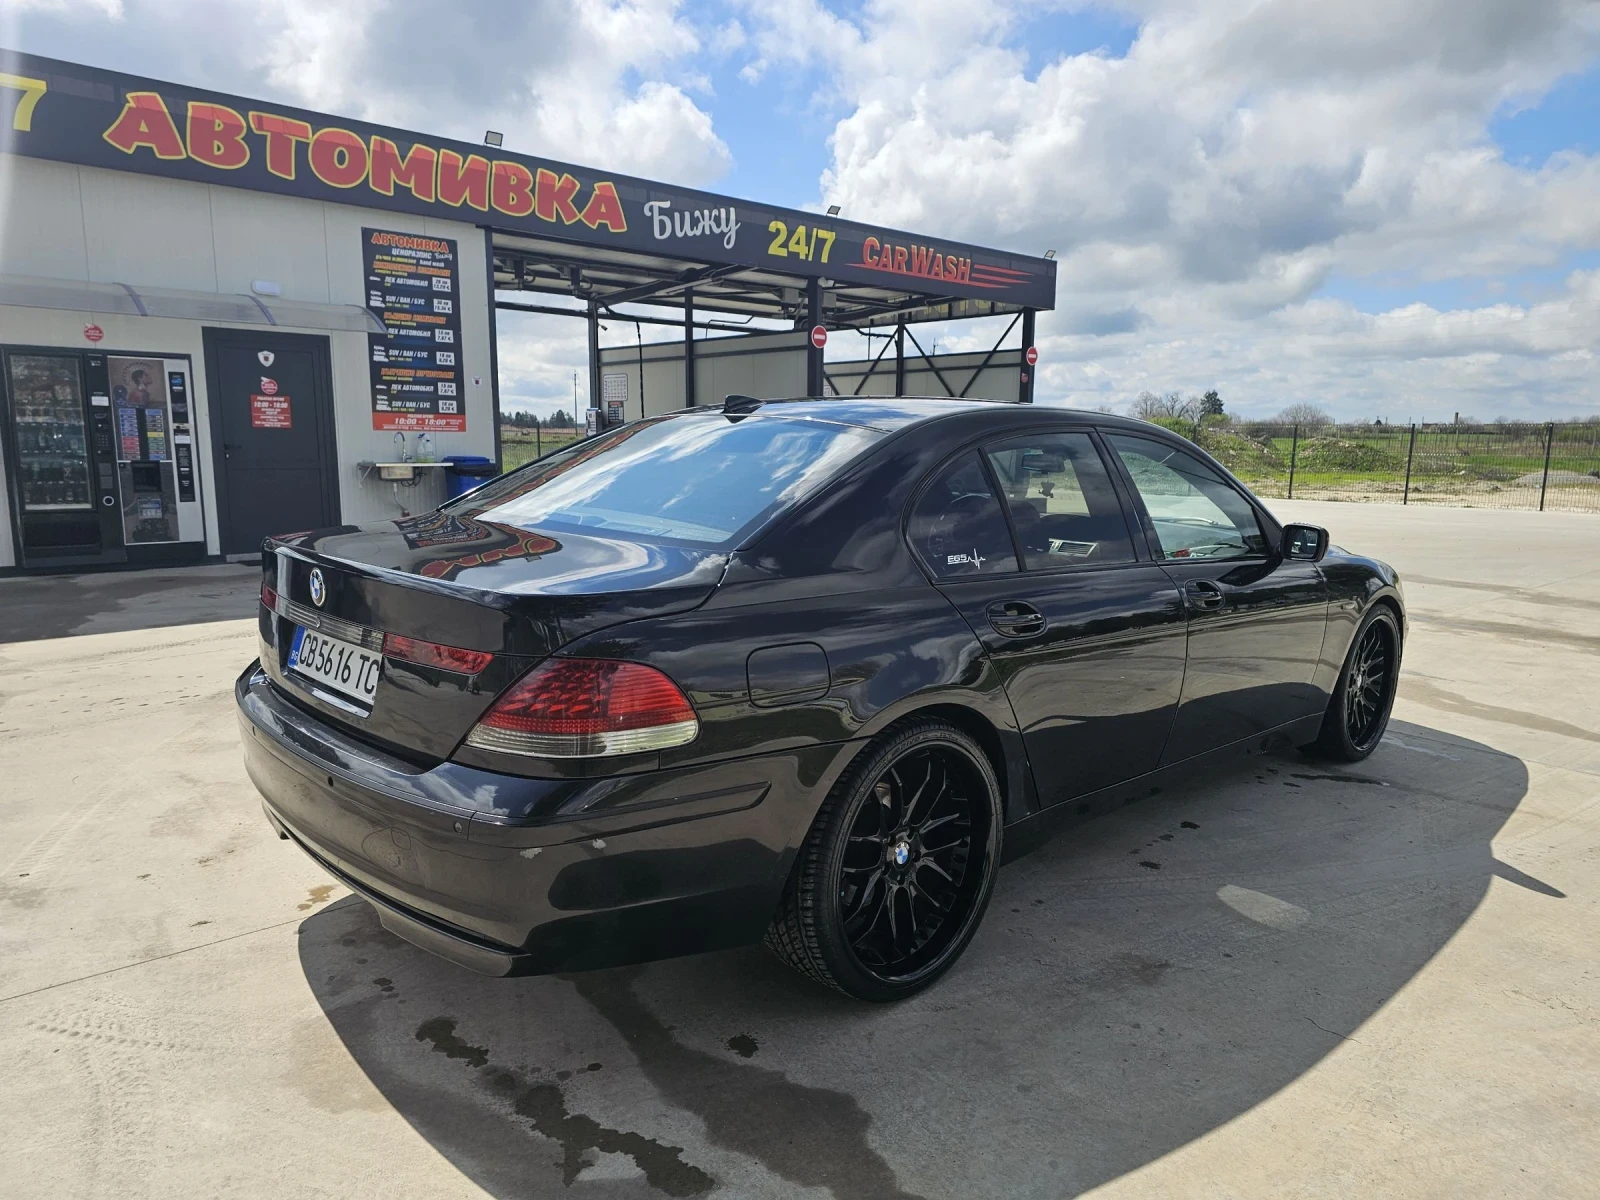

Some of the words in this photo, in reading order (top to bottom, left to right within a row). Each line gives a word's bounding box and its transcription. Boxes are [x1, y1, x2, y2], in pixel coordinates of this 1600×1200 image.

[103, 91, 628, 232] АВТОМИВКА
[643, 200, 742, 249] Бижу
[371, 232, 449, 253] АВТОМИВКА
[768, 220, 836, 264] 24/7
[391, 248, 433, 259] ЦЕНОРАЗПИС
[396, 278, 428, 287] АВТОМОБИЛ
[399, 328, 431, 337] АВТОМОБИЛ
[947, 554, 967, 562] E65
[355, 653, 380, 695] TC
